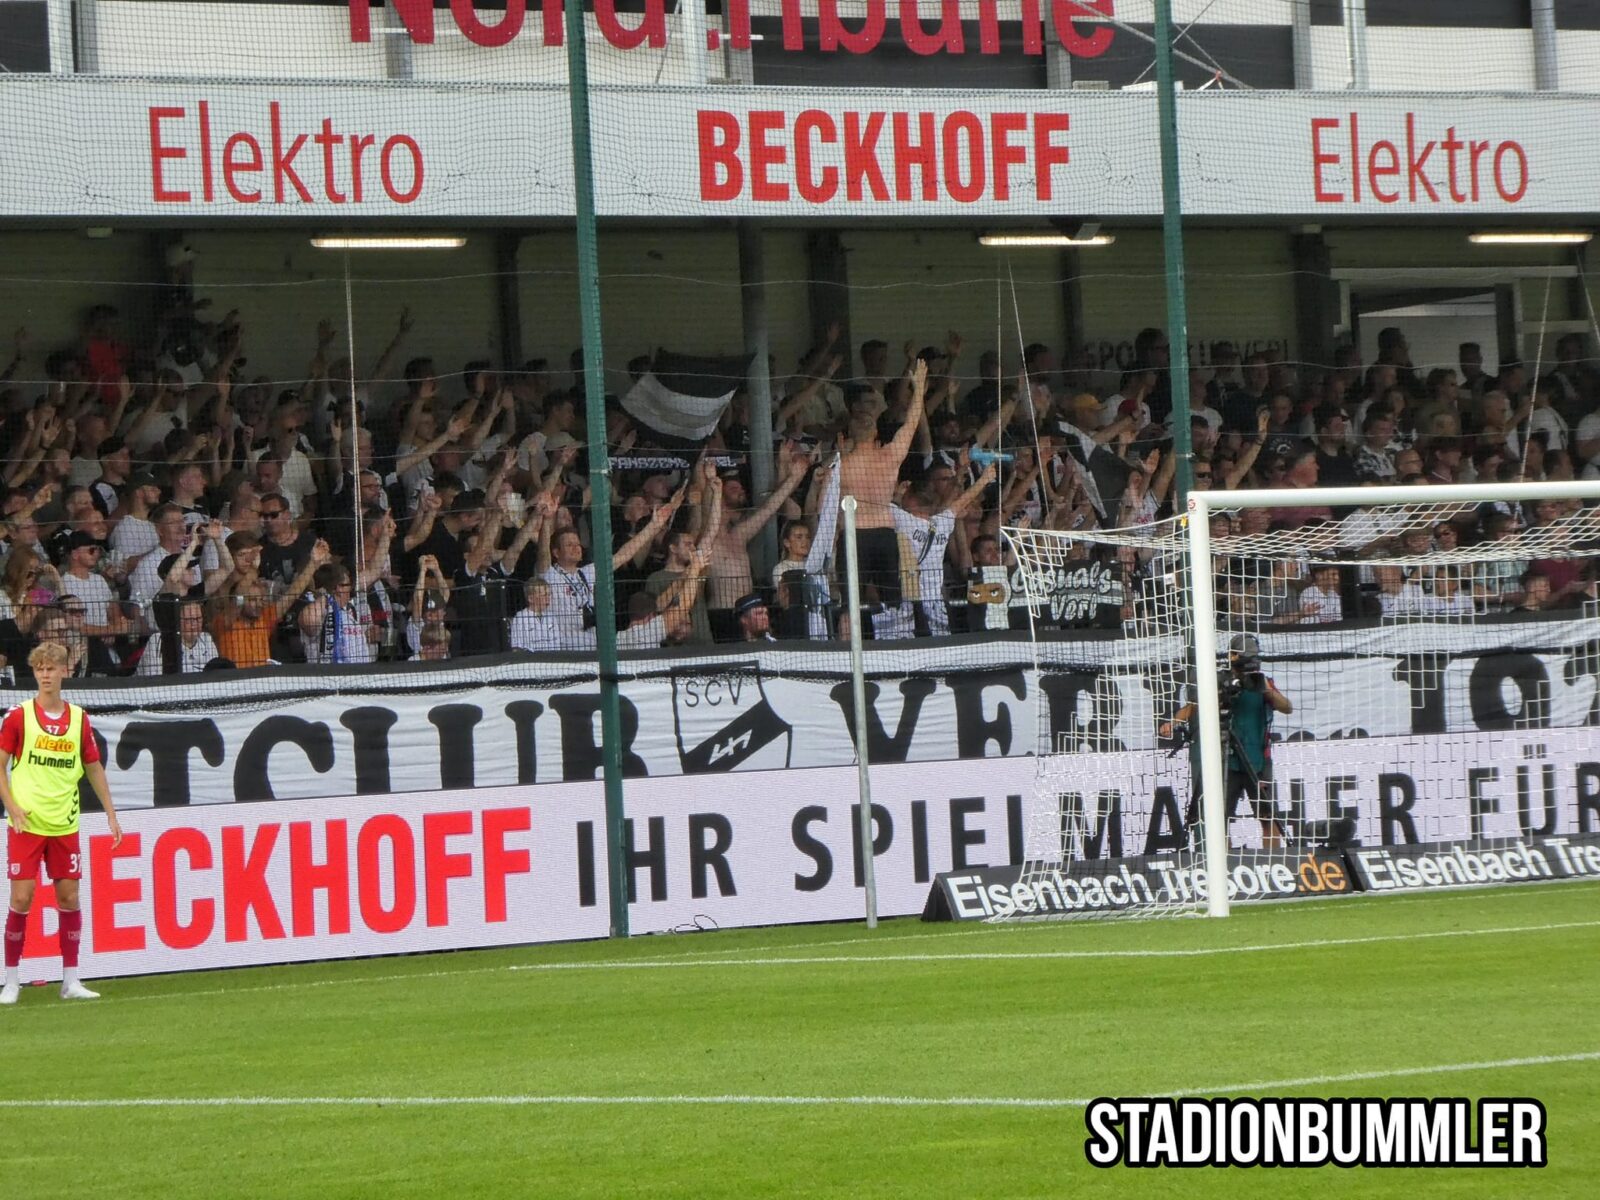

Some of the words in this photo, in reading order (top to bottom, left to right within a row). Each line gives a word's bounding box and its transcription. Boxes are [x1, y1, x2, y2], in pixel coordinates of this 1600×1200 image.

[149, 100, 425, 204] Elektro
[697, 109, 1070, 203] BECKHOFF
[1311, 112, 1528, 203] Elektro
[684, 674, 743, 708] SCV
[28, 750, 76, 769] hummel
[35, 735, 75, 753] Netto
[577, 813, 738, 907] IHR
[1356, 840, 1552, 890] Eisenbach
[946, 864, 1156, 919] Eisenbach
